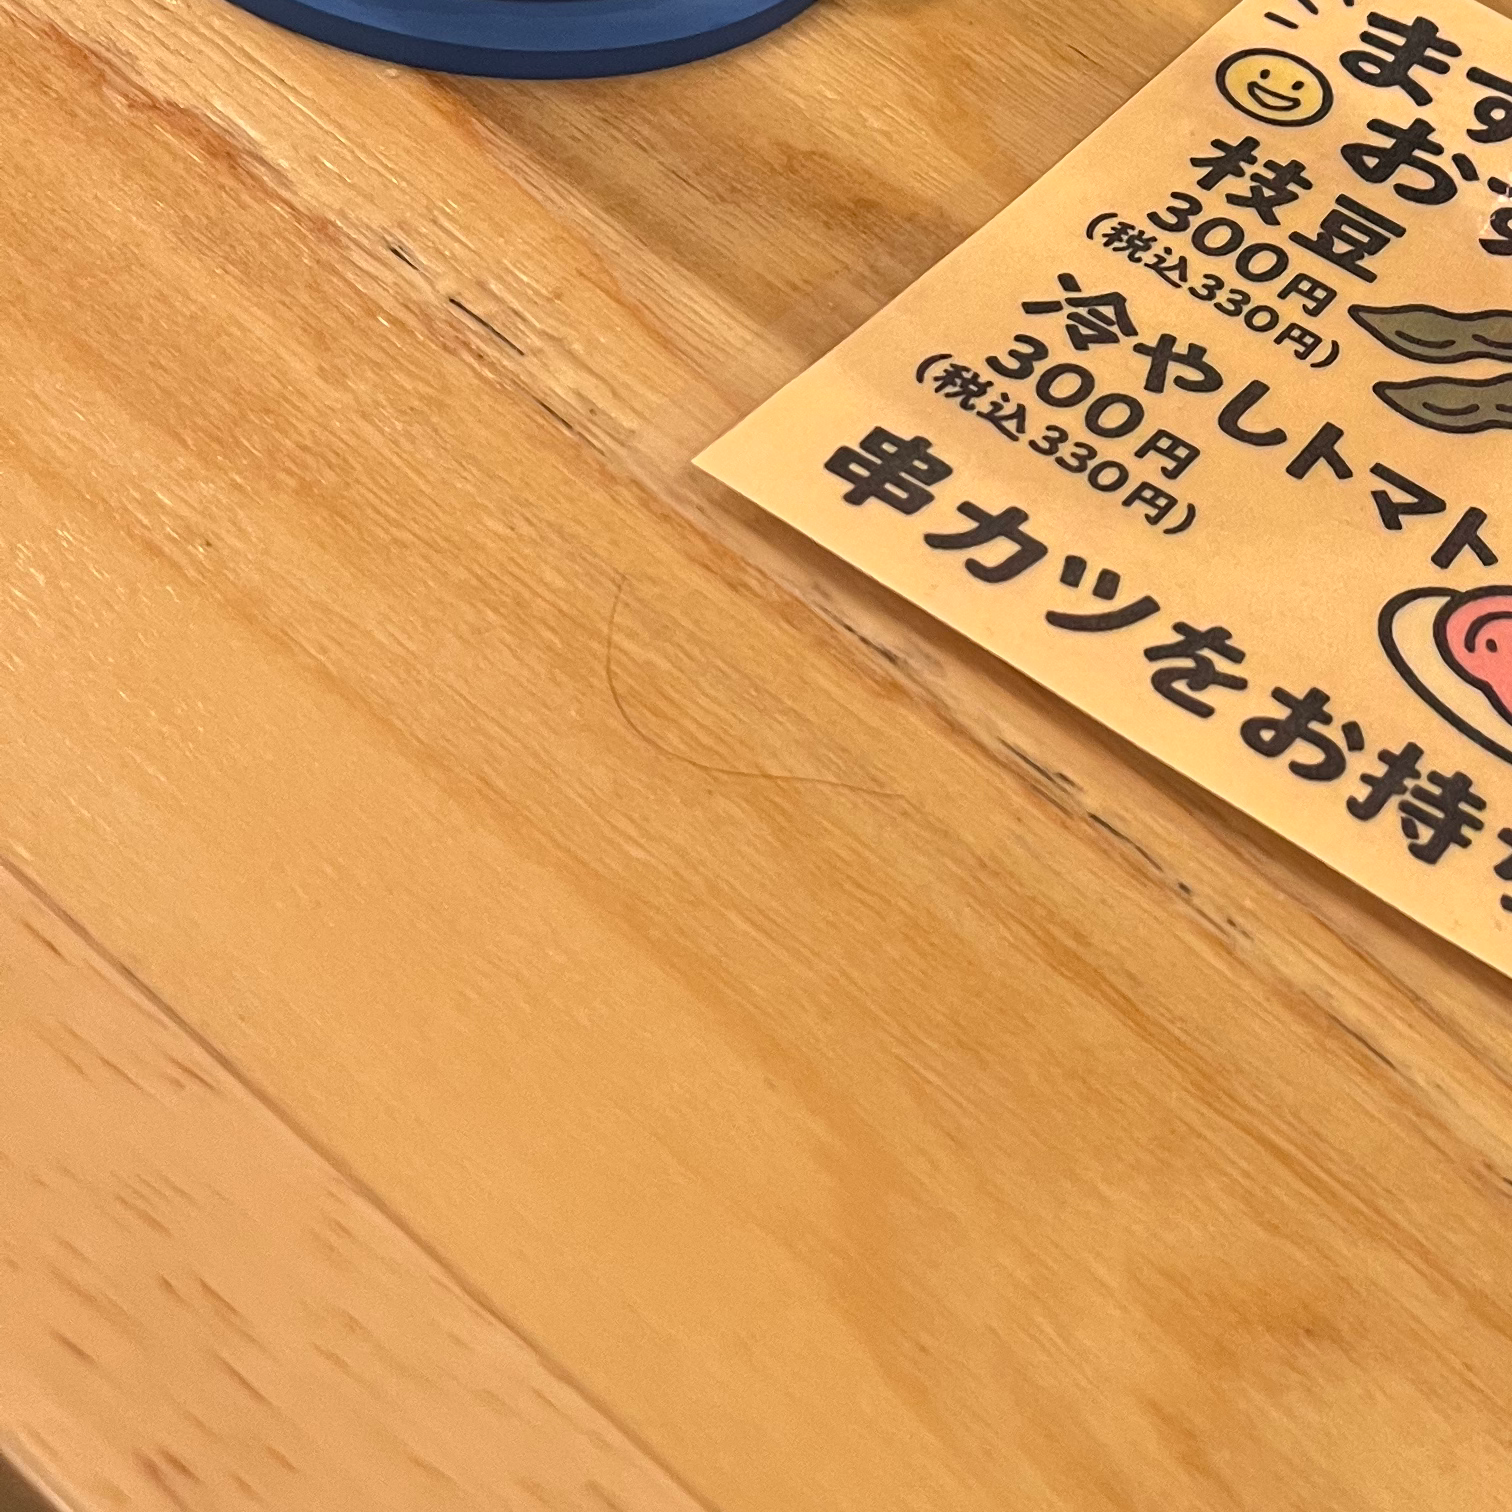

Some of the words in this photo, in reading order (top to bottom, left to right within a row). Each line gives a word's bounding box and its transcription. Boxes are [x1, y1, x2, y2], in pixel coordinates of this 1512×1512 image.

[1147, 191, 1337, 318] 300円
[1189, 136, 1406, 283] 枝豆
[1085, 211, 1341, 369] (税込330円)
[915, 354, 1197, 535] (税込330円)
[985, 333, 1200, 480] 300円
[1021, 272, 1499, 569] 冷やしトマト
